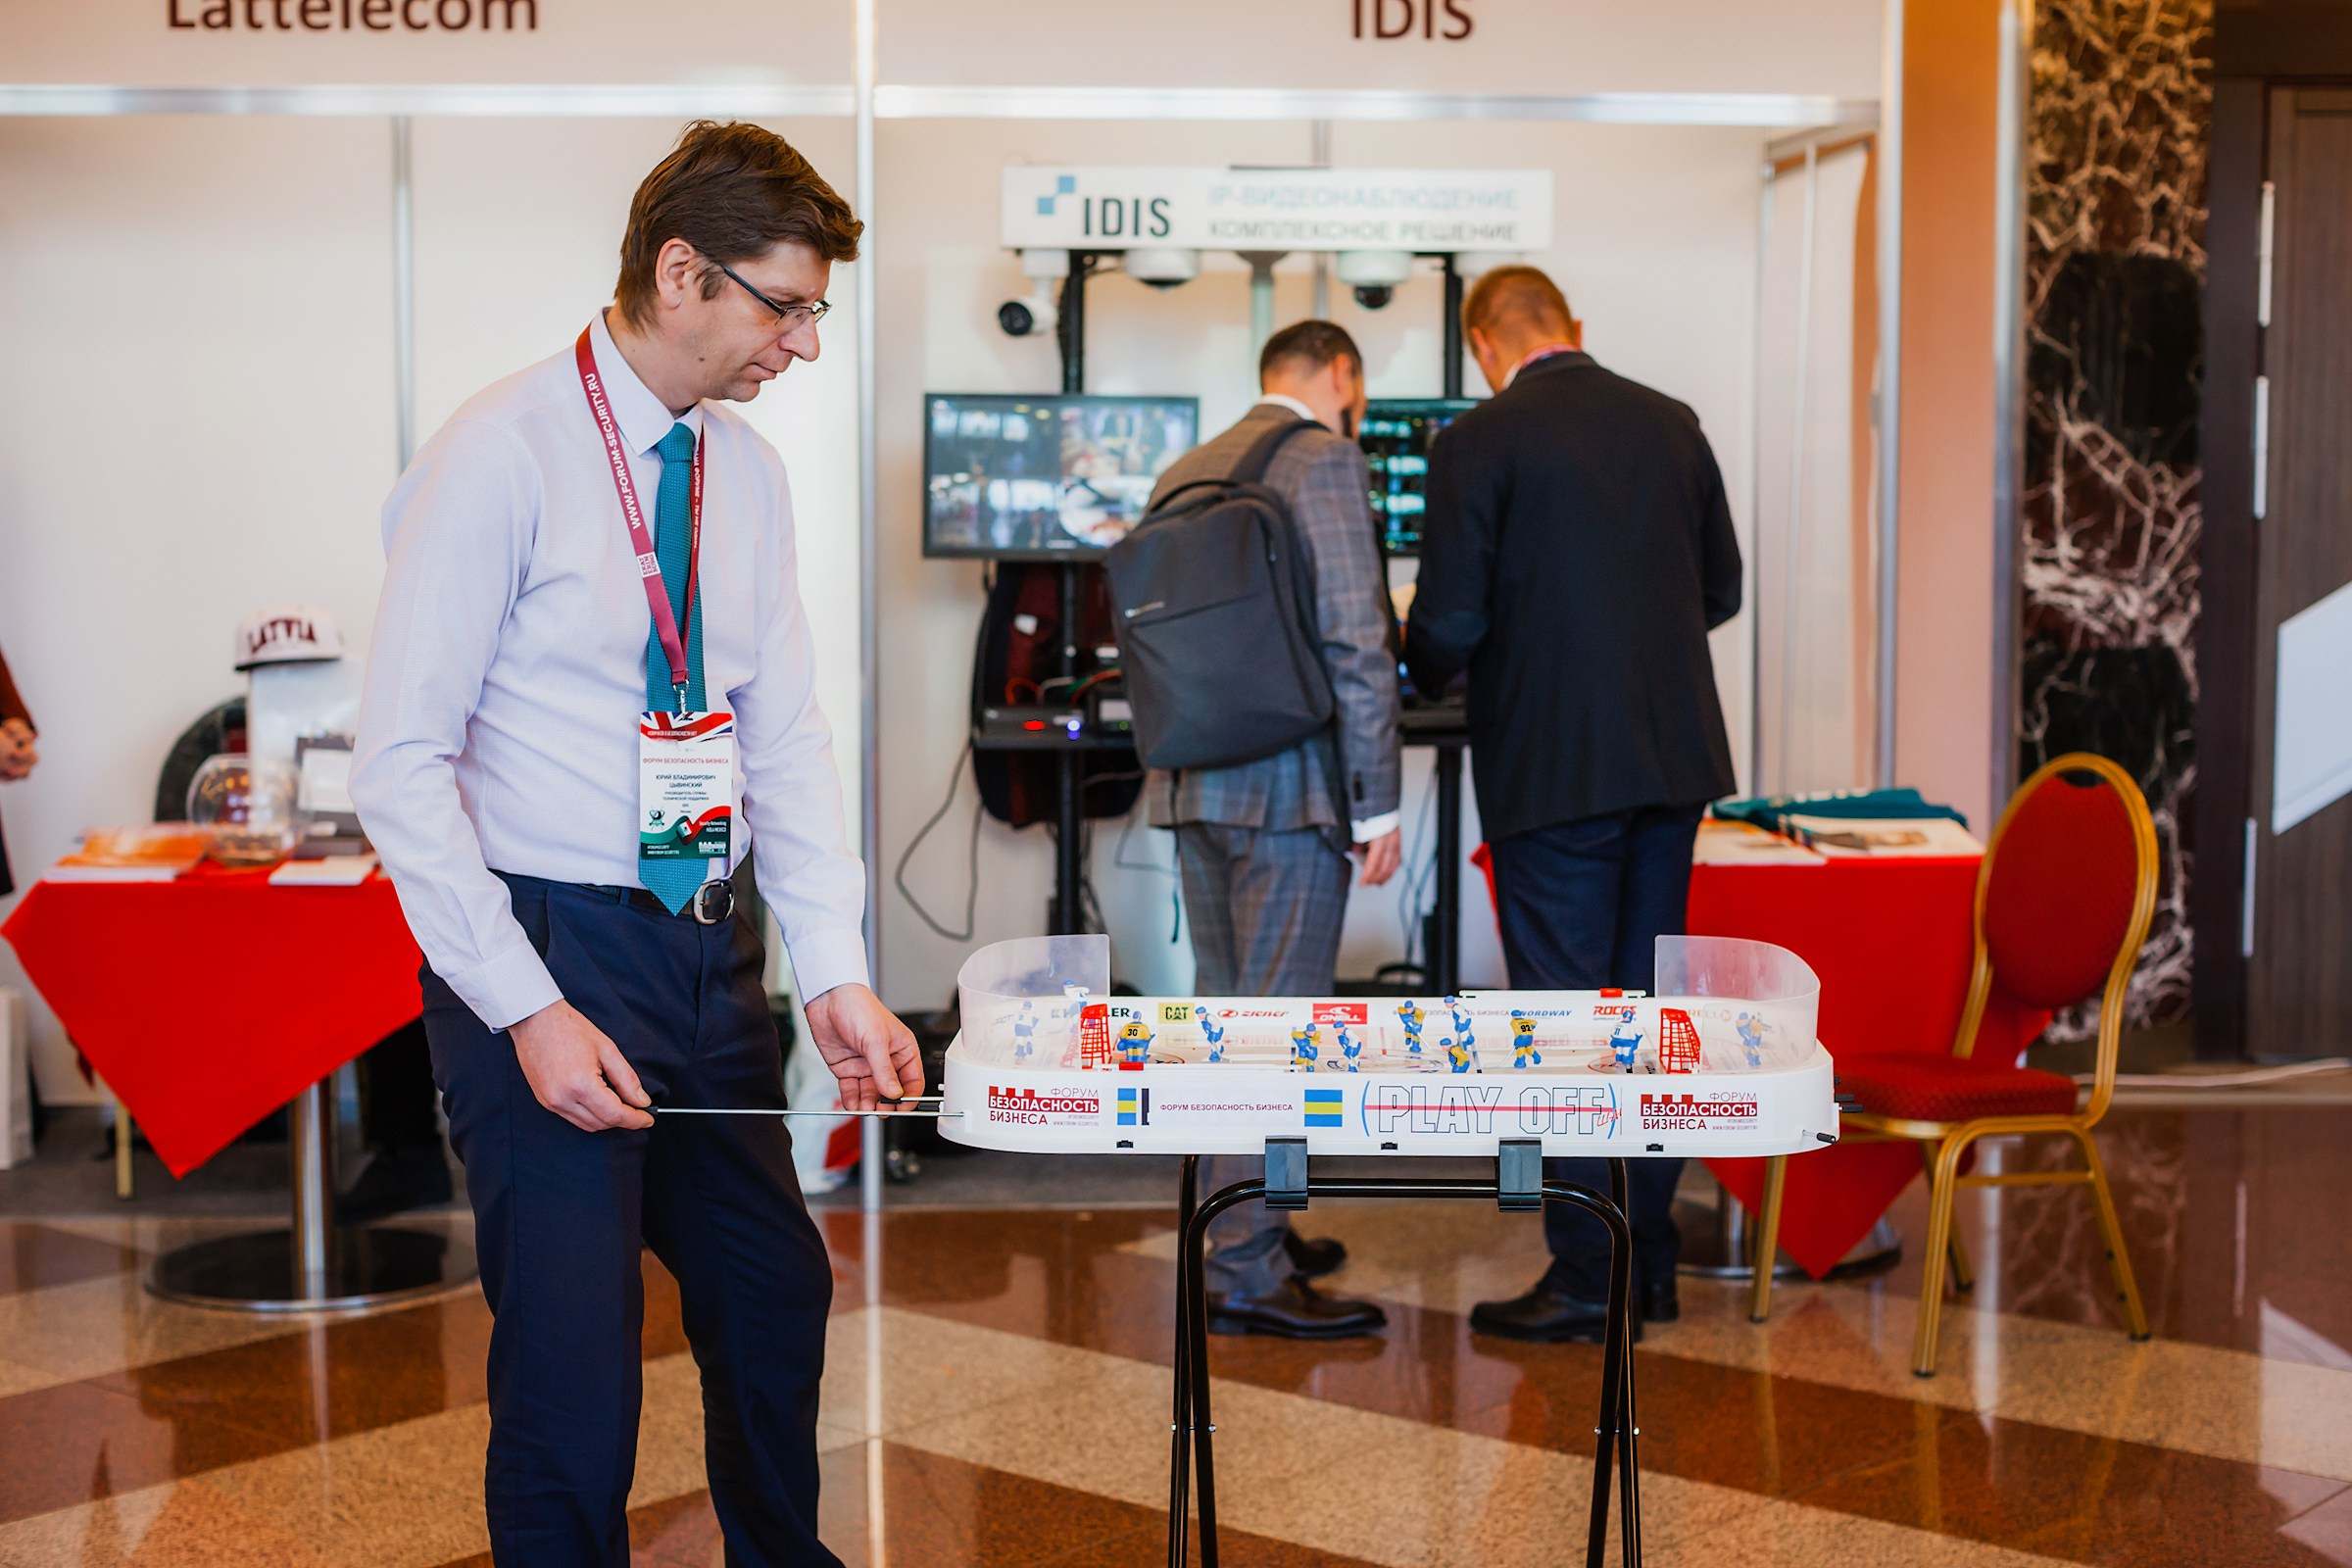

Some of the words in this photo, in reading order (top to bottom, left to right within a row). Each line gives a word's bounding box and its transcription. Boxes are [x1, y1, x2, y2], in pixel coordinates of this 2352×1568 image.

[168, 0, 539, 31] Lattelecom
[1352, 0, 1473, 40] IDIS
[1208, 185, 1518, 211] IP-ВИДЕОНАБЛЮДЕНИЕ
[1083, 198, 1172, 237] IDIS
[1209, 220, 1390, 241] КОМПЛЕКСНОЕ
[1399, 220, 1518, 242] РЕШЕНИЕ
[584, 372, 642, 530] WWW.FORUM-SECURITY.RU
[247, 616, 317, 656] LATVIA
[1165, 1006, 1189, 1020] CAT
[1128, 1028, 1138, 1037] 30
[1520, 1024, 1532, 1033] 92
[1051, 1087, 1099, 1098] ФОРУМ
[1709, 1092, 1757, 1101] ФОРУМ
[990, 1096, 1099, 1112] БЕЗОПАСНОСТЬ
[1379, 1086, 1502, 1133] PLAY
[1519, 1088, 1604, 1134] OFF
[1642, 1103, 1757, 1116] БЕЗОПАСНОСТЬ
[990, 1110, 1048, 1125] БИЗНЕСА
[1642, 1118, 1707, 1130] БИЗНЕСА
